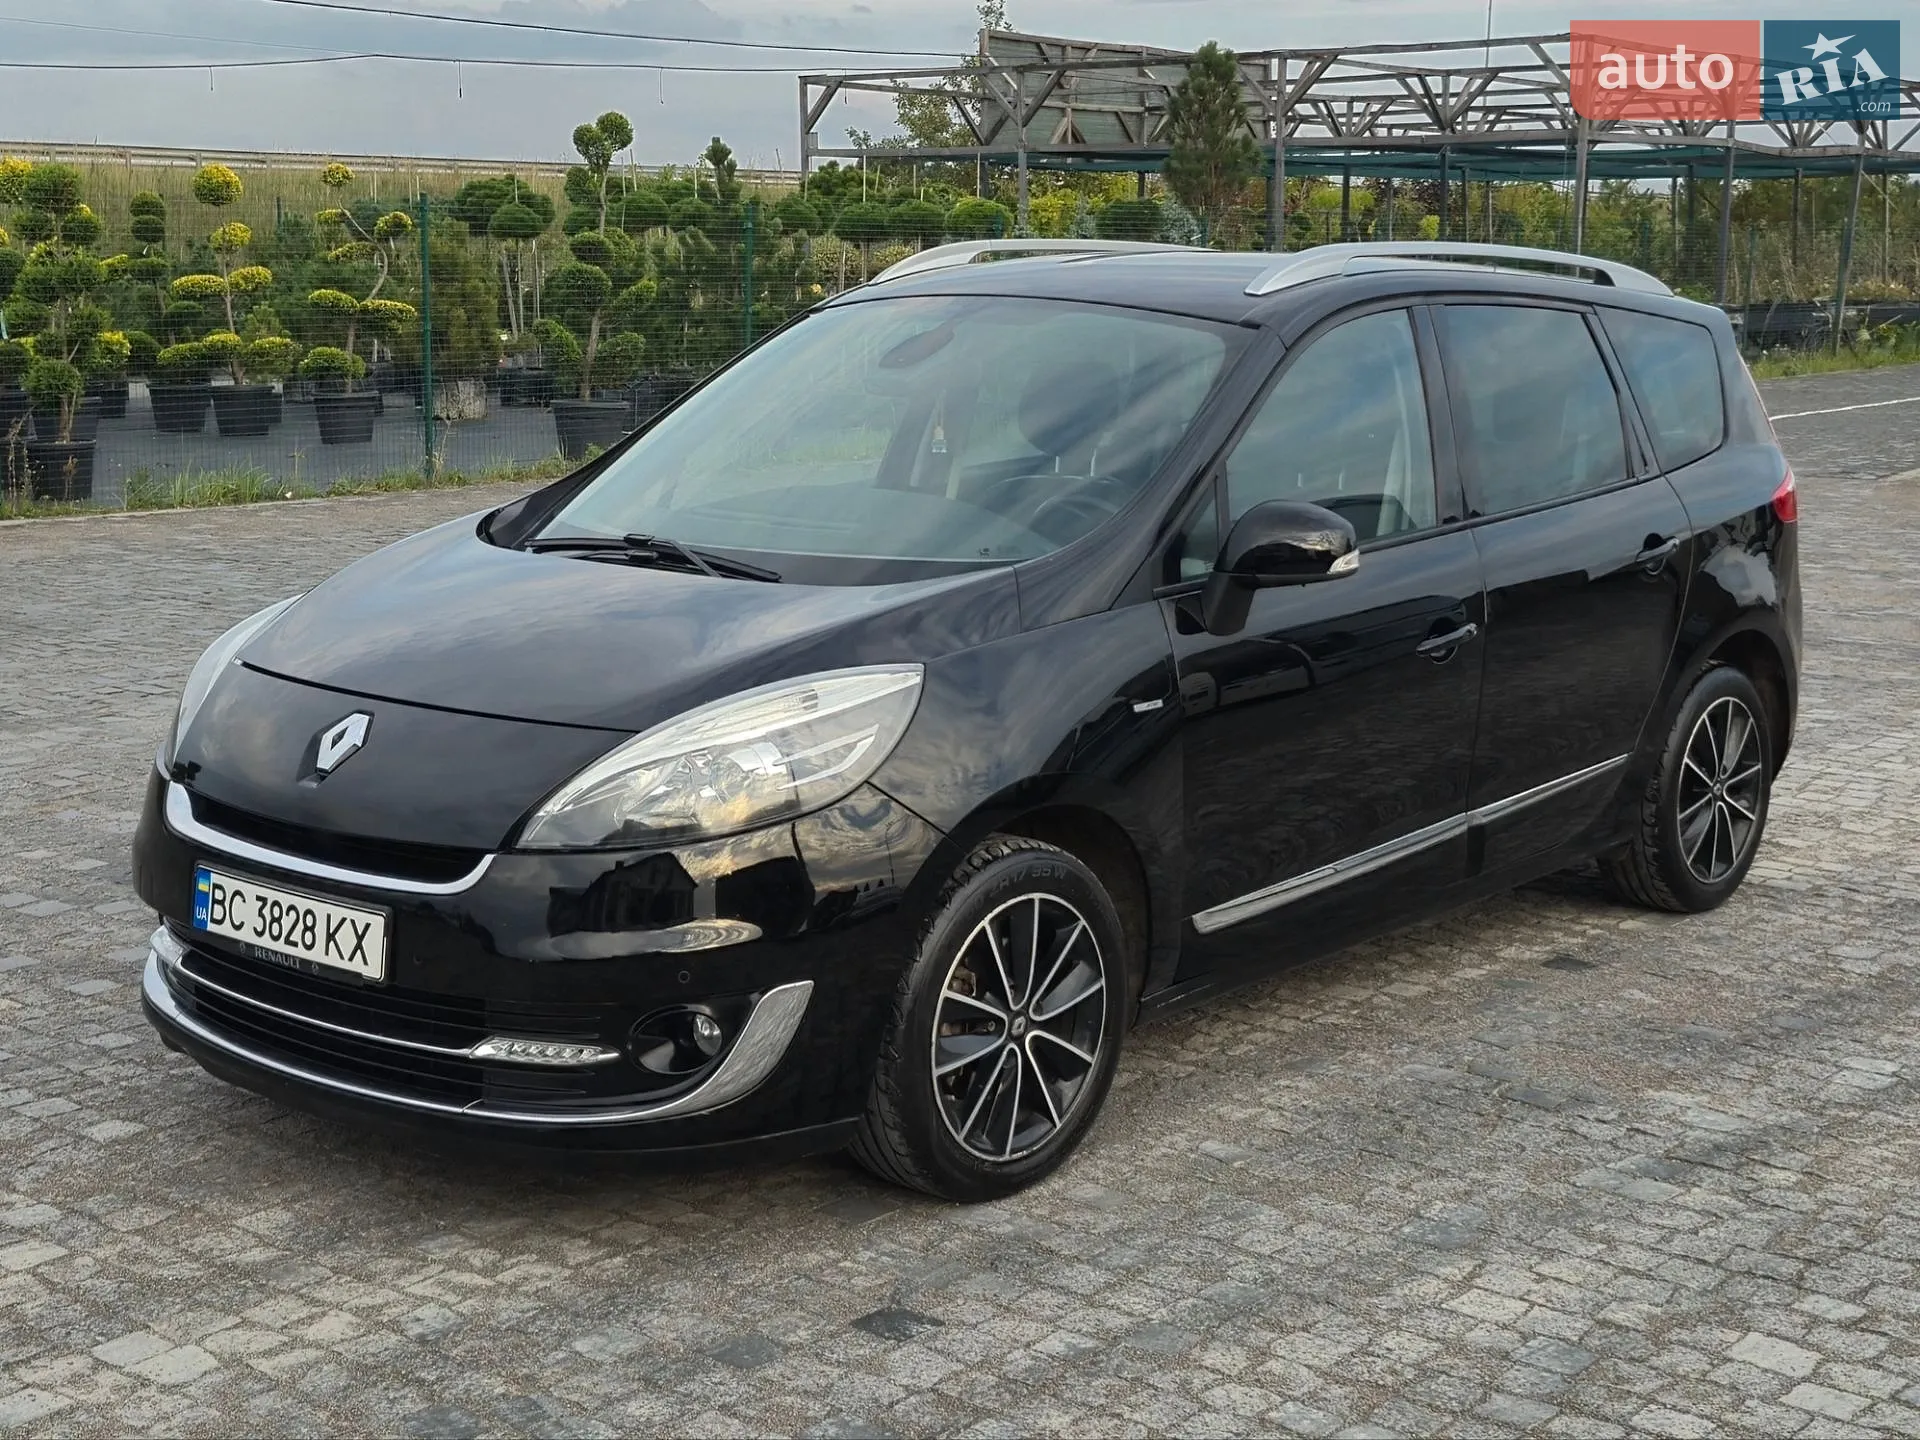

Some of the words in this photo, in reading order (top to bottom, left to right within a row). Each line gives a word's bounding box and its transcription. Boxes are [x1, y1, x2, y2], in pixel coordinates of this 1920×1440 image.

[196, 905, 207, 921] UA
[210, 883, 246, 931] BC
[253, 894, 317, 951] 3828
[324, 913, 372, 966] KX
[254, 946, 300, 969] RENAULT
